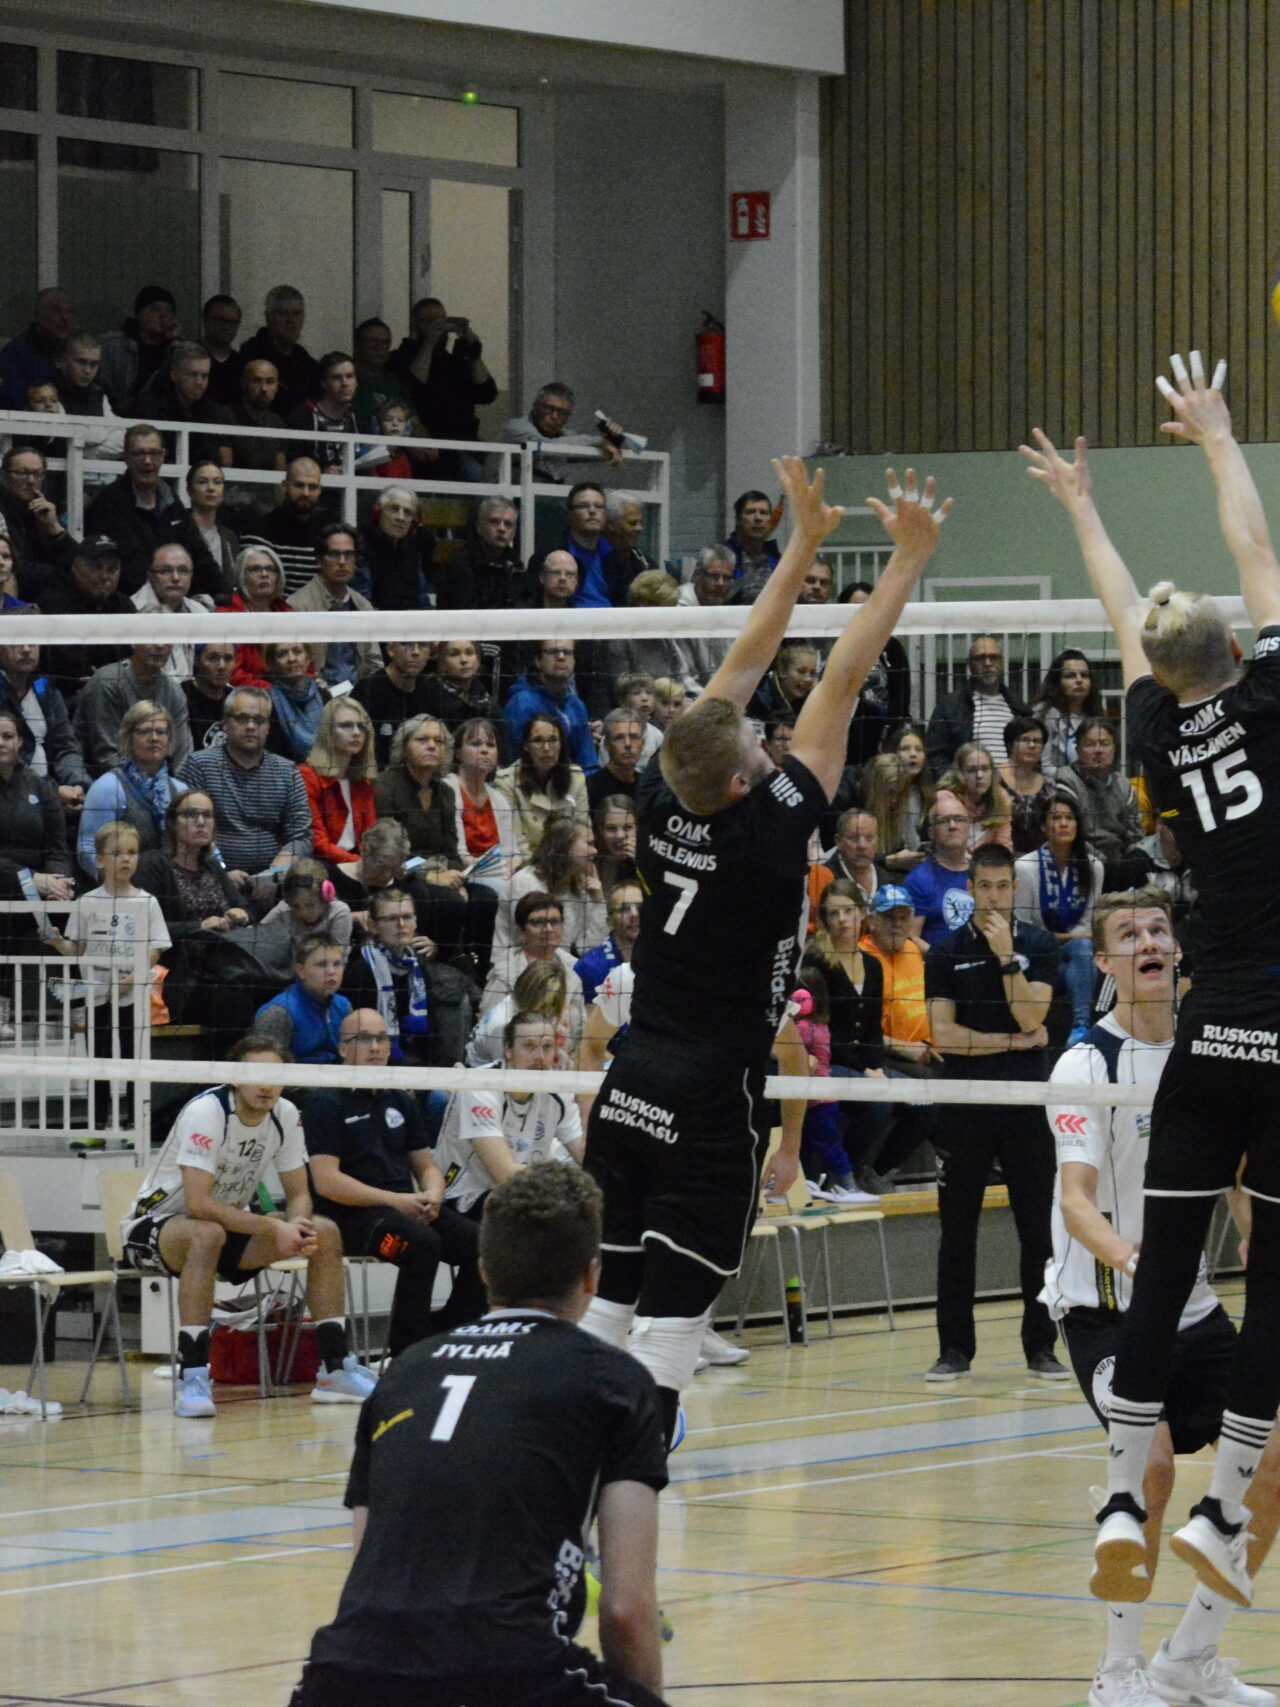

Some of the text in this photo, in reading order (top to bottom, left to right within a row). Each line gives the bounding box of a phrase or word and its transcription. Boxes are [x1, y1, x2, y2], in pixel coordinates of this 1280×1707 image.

[1168, 721, 1247, 767] VÄISÄNEN
[1180, 748, 1263, 833] 15
[648, 834, 718, 872] HELENIUS
[663, 870, 699, 936] 7
[766, 935, 796, 1028] Bitfacr
[1203, 1024, 1279, 1047] RUSKON
[599, 1104, 680, 1145] BIOKAASU
[610, 1088, 675, 1127] RUSKON
[238, 1137, 257, 1158] 12
[431, 1340, 515, 1359] JYLHÄ
[429, 1374, 478, 1442] 1
